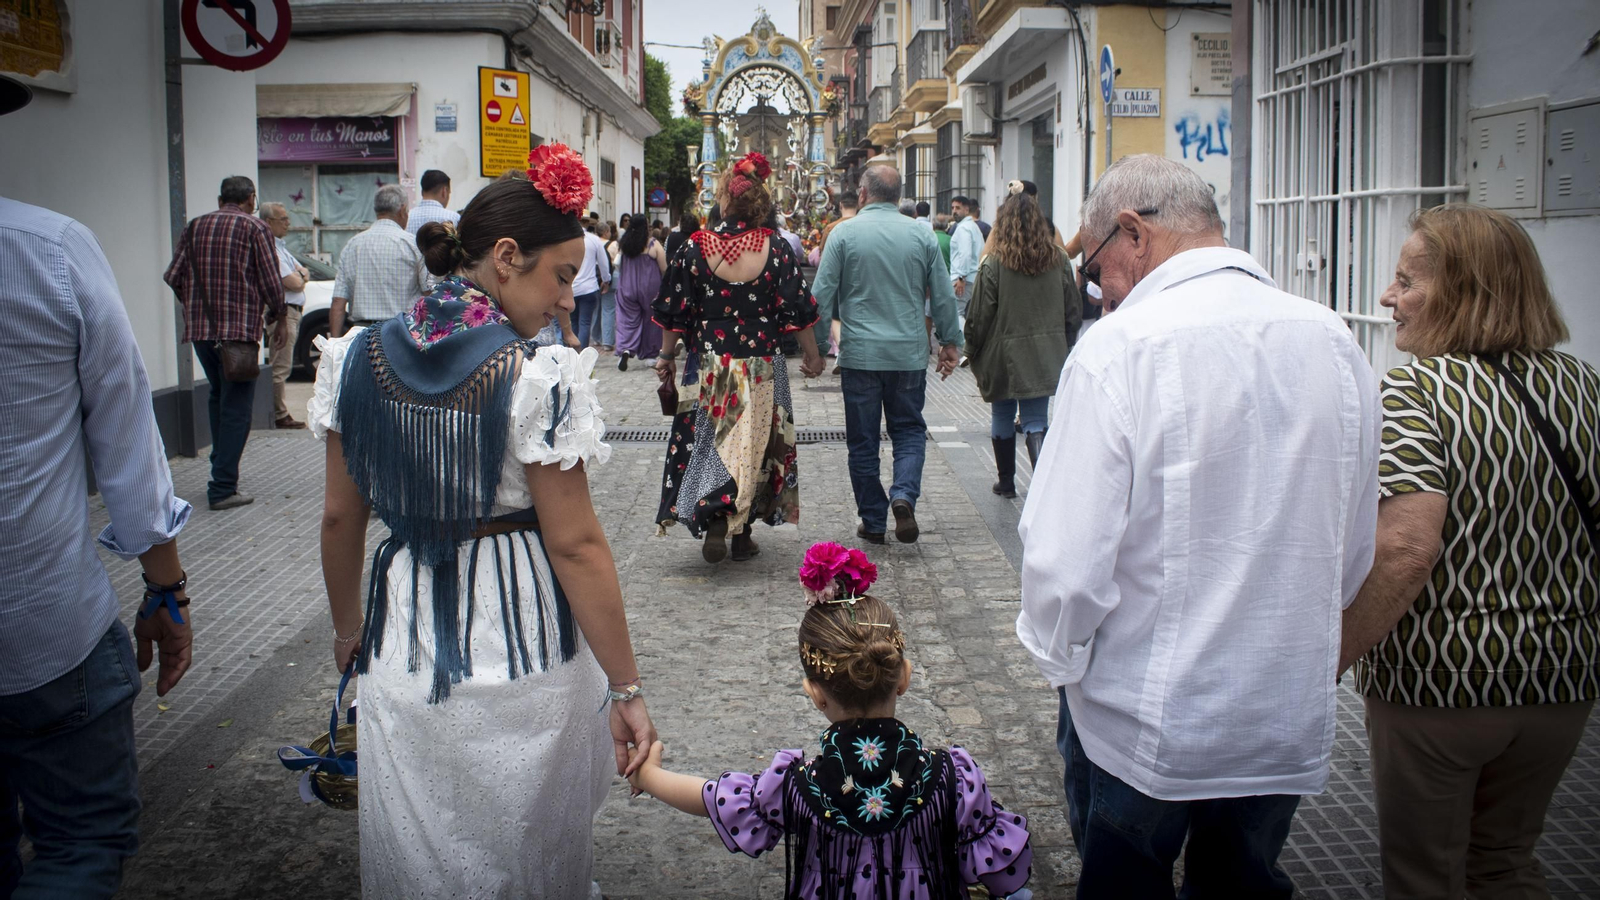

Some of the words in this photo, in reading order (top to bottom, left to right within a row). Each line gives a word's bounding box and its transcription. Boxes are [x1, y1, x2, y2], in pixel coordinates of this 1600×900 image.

[1198, 39, 1228, 51] CECILIO
[1124, 91, 1152, 101] CALLE
[1112, 104, 1129, 114] CILIO
[288, 132, 306, 143] en
[310, 122, 334, 143] tus
[335, 121, 391, 144] Manos
[743, 125, 783, 137] HERMNDAD
